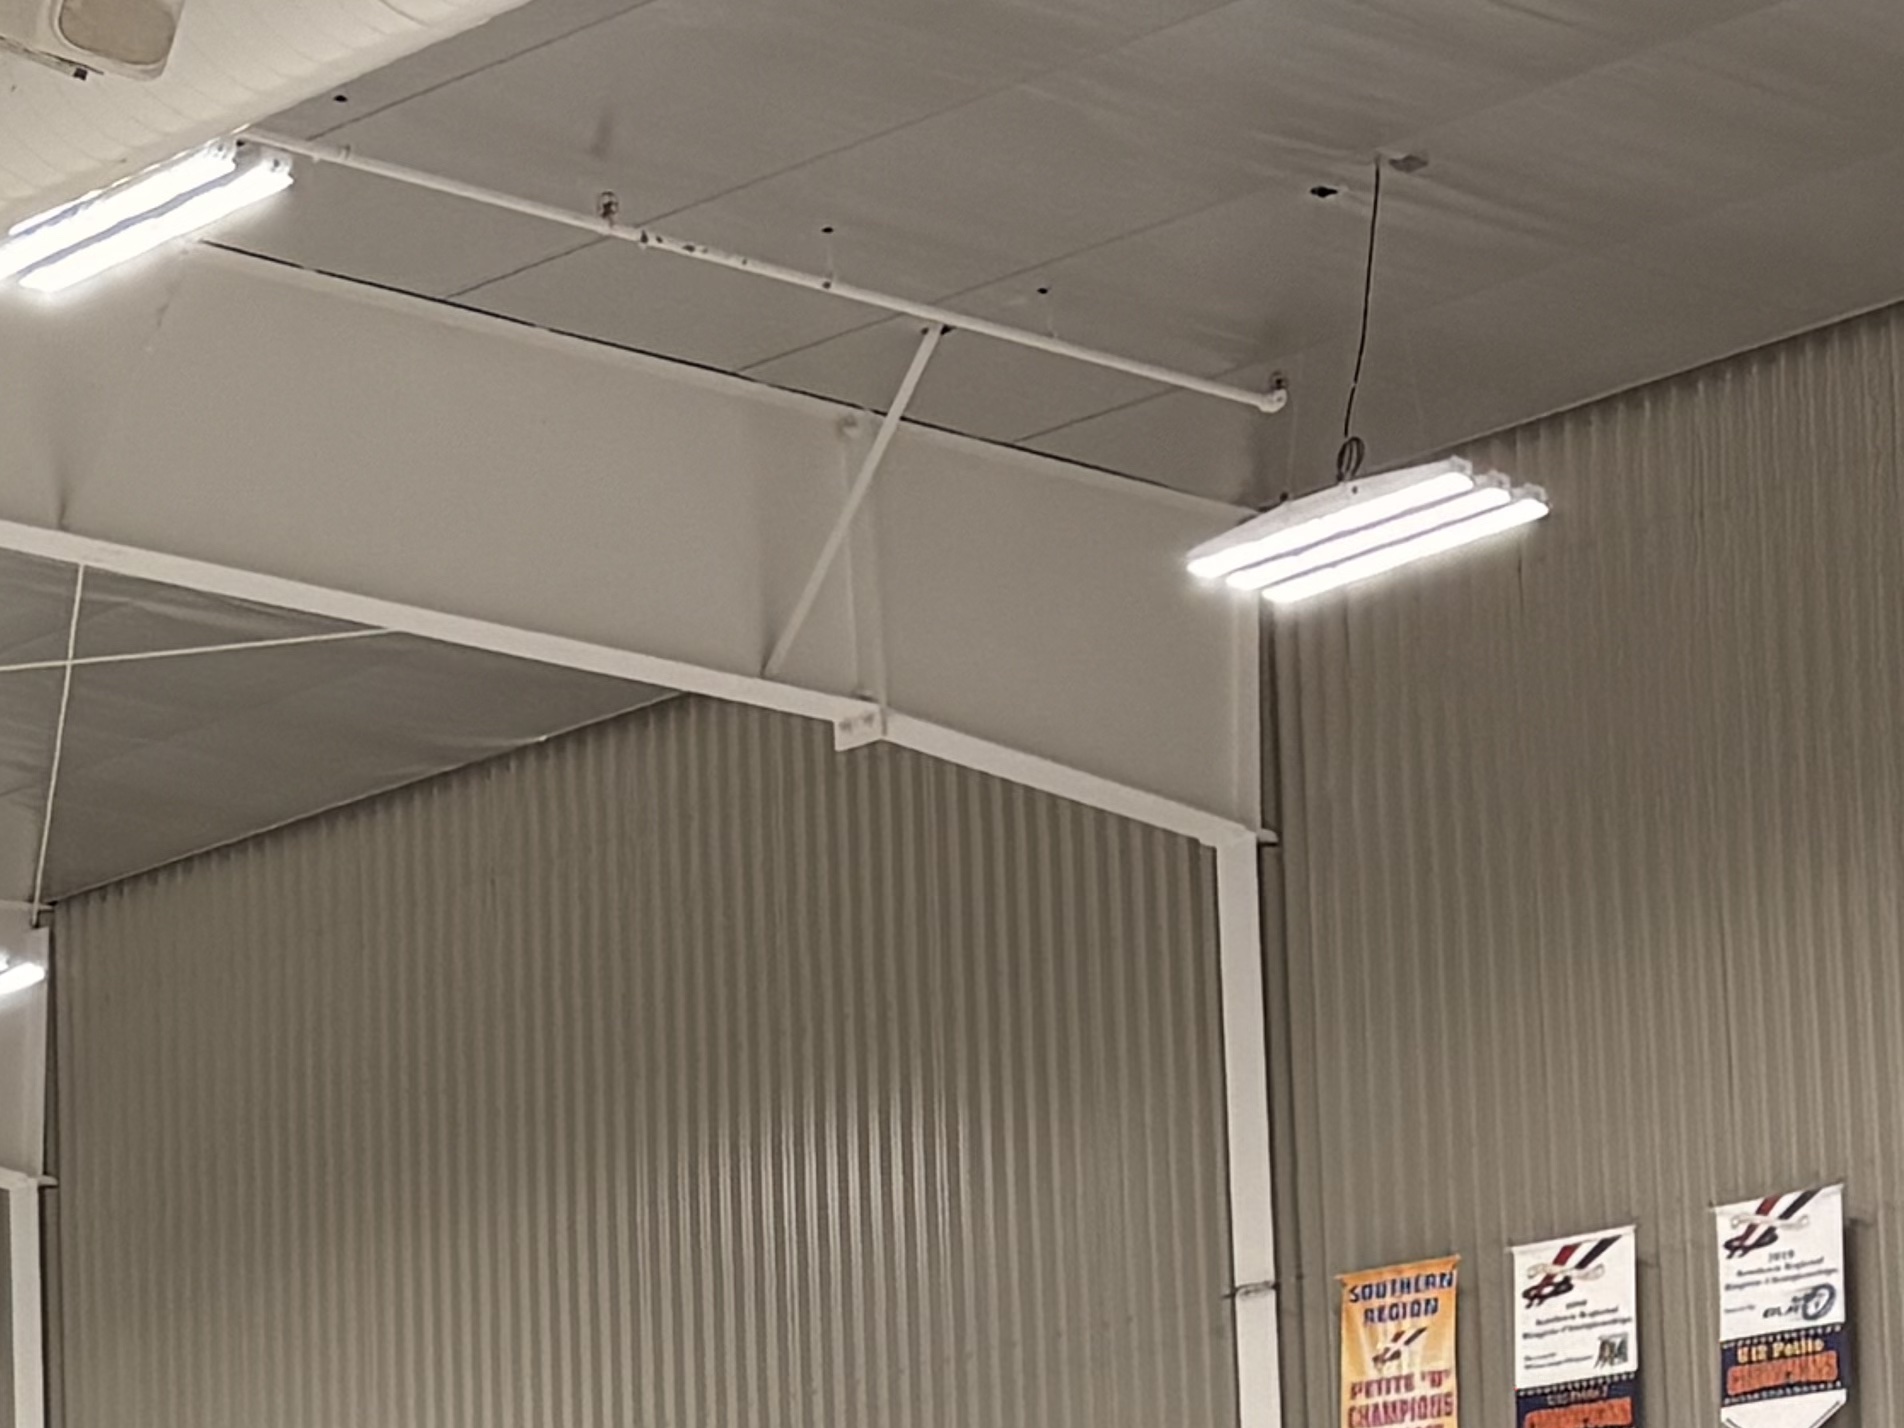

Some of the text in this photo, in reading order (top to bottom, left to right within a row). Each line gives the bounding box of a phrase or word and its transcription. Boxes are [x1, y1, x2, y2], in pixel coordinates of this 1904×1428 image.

[1349, 1272, 1453, 1303] SOUTHERN
[1364, 1298, 1439, 1323] REGION
[1350, 1372, 1414, 1400] PETITE
